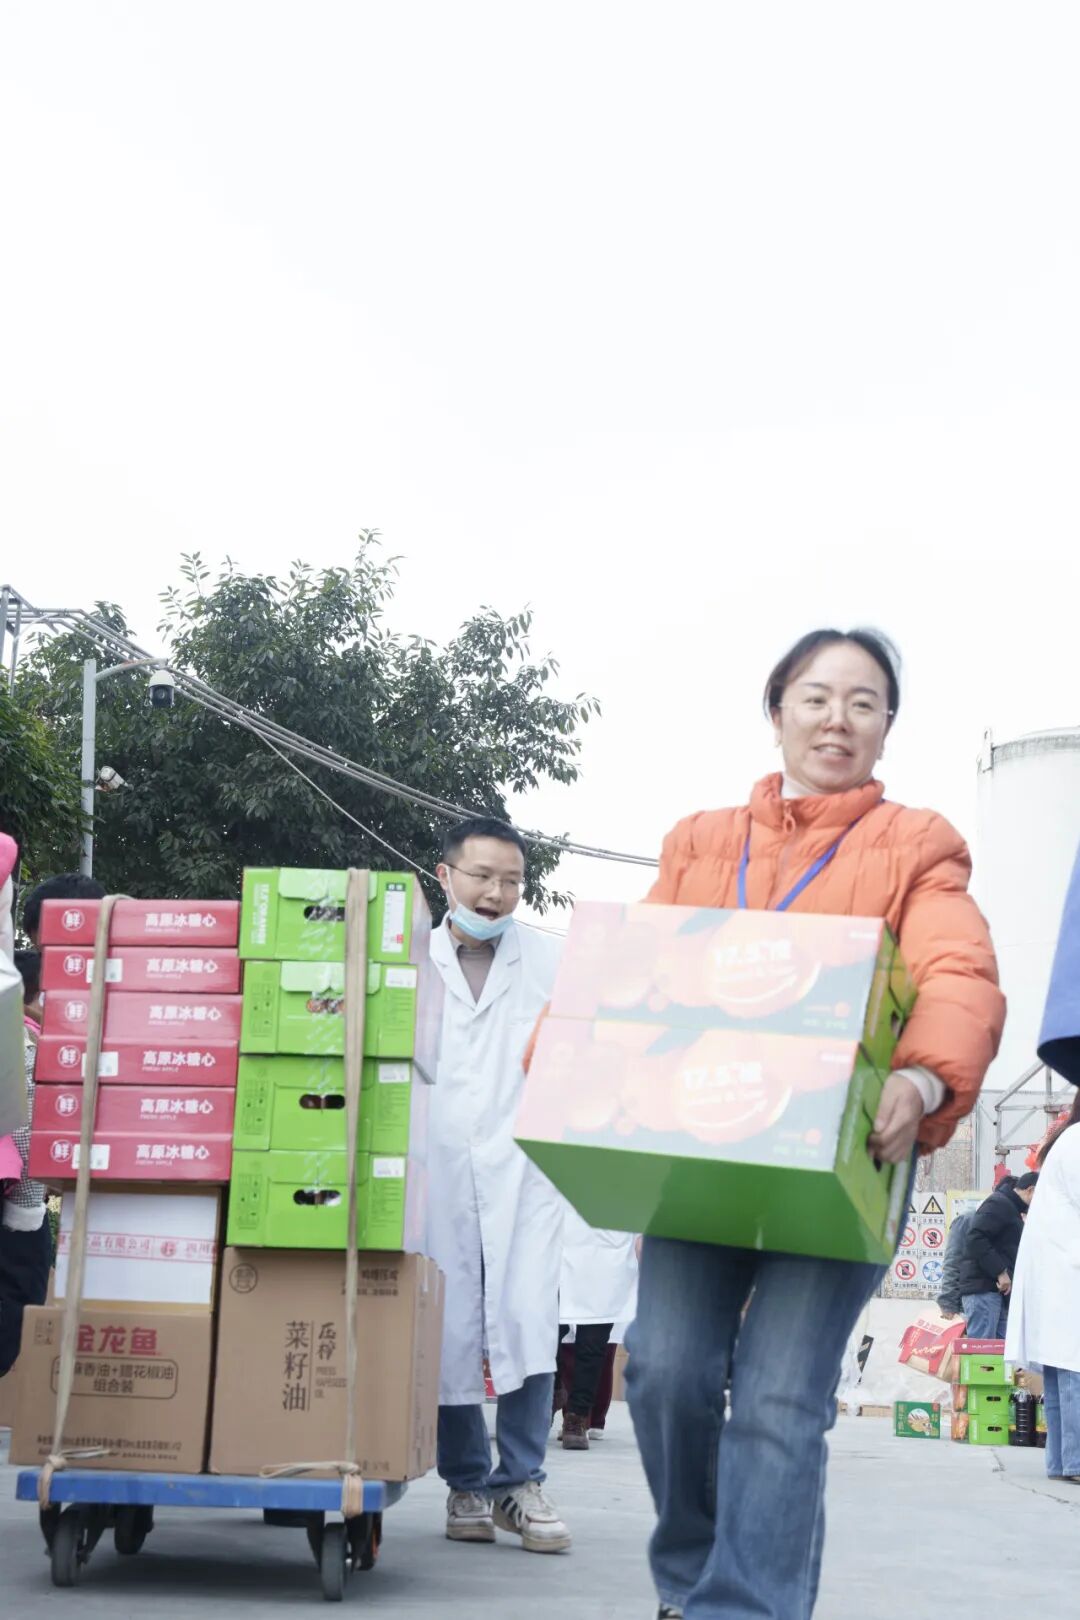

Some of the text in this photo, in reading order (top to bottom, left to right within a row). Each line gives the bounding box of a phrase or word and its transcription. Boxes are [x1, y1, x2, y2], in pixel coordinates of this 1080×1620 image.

[65, 911, 81, 928] 鲜
[145, 912, 217, 928] 高原冰糖心
[66, 956, 82, 973] 鲜
[146, 958, 219, 974] 高原冰糖心
[61, 1048, 77, 1064] 鲜
[143, 1050, 216, 1067] 高原冰糖心
[58, 1096, 75, 1113] 鲜
[140, 1098, 214, 1114] 高原冰糖心
[53, 1142, 70, 1159] 鲜
[136, 1144, 210, 1160] 高原冰糖心
[77, 1324, 157, 1356] 金龙鱼
[283, 1320, 309, 1411] 菜籽油
